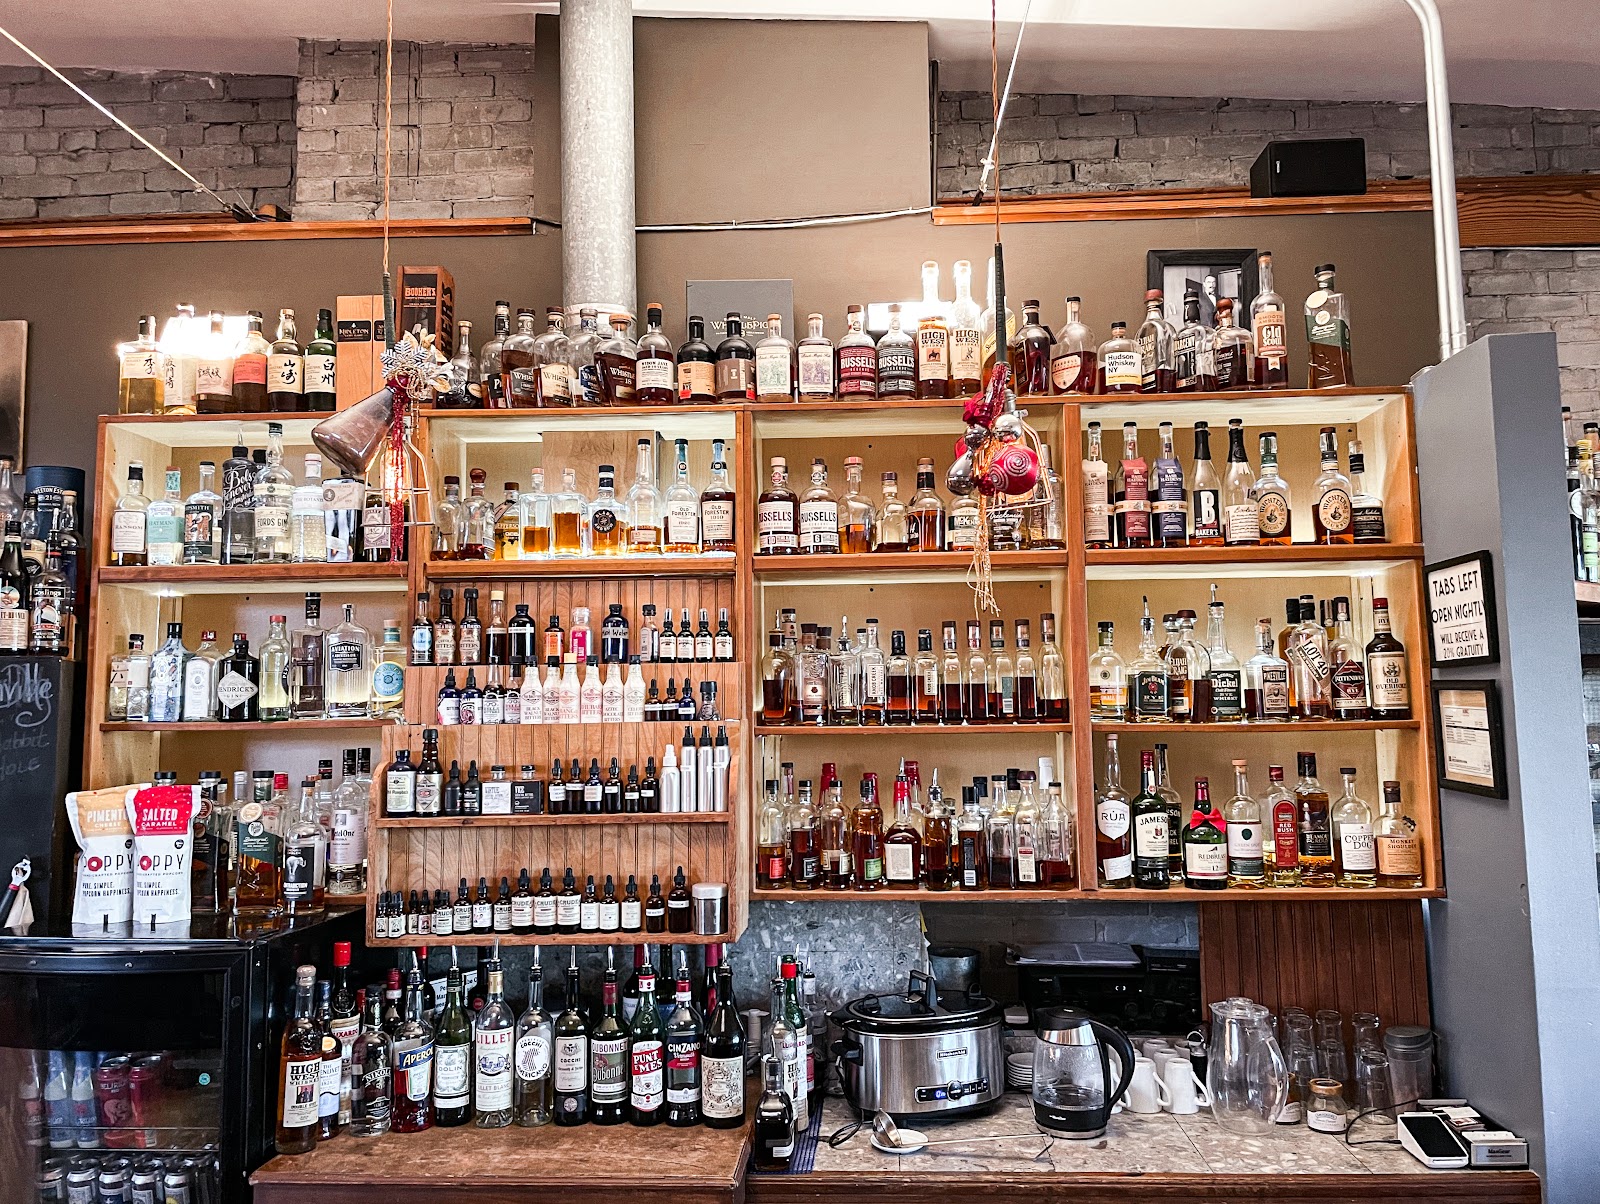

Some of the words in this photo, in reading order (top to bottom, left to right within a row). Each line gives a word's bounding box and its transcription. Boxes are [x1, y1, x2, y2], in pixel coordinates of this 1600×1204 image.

[405, 288, 436, 297] BOOKER'S
[921, 331, 945, 339] HIGH
[955, 329, 980, 339] HIGH
[841, 356, 876, 369] RUSSELL'S
[879, 355, 915, 368] RUSSELL'S
[1108, 360, 1137, 368] Whiskey
[711, 504, 722, 512] OLD
[1200, 491, 1216, 525] B
[257, 517, 276, 528] FORDS
[277, 516, 288, 526] GIN
[801, 511, 837, 523] RUSSELL'S
[1195, 528, 1220, 536] BAKER'S
[1432, 576, 1456, 597] TABS
[1457, 570, 1479, 592] LEFT
[33, 588, 62, 598] Goslings
[1431, 606, 1453, 624] OPEN
[1440, 632, 1454, 644] WILL
[1454, 629, 1478, 643] RECEIVE
[1479, 629, 1485, 640] A
[1443, 648, 1455, 659] 20%
[1456, 643, 1484, 657] GRATUITY
[1302, 641, 1322, 663] LOT
[1317, 660, 1329, 677] 40
[1142, 678, 1151, 686] JIM
[1150, 677, 1165, 685] BEAM
[1211, 678, 1239, 689] Dickel
[142, 808, 179, 821] SALTED
[1140, 815, 1168, 826] JAMESO
[1353, 841, 1373, 850] DOG
[93, 882, 115, 890] SIMPLE.
[144, 881, 163, 889] SIMPLE.
[150, 887, 181, 897] HAPPINESS.
[476, 1033, 512, 1046] LILLET
[520, 1041, 543, 1049] COCCHI
[667, 1043, 700, 1054] CINZANO
[402, 1048, 433, 1067] APEROL
[633, 1051, 659, 1063] PUNT
[290, 1063, 320, 1077] HIGH
[516, 1063, 549, 1079] AMERICANO
[639, 1060, 662, 1073] MES
[290, 1073, 320, 1083] WEST
[320, 1067, 340, 1078] ENLIVET
